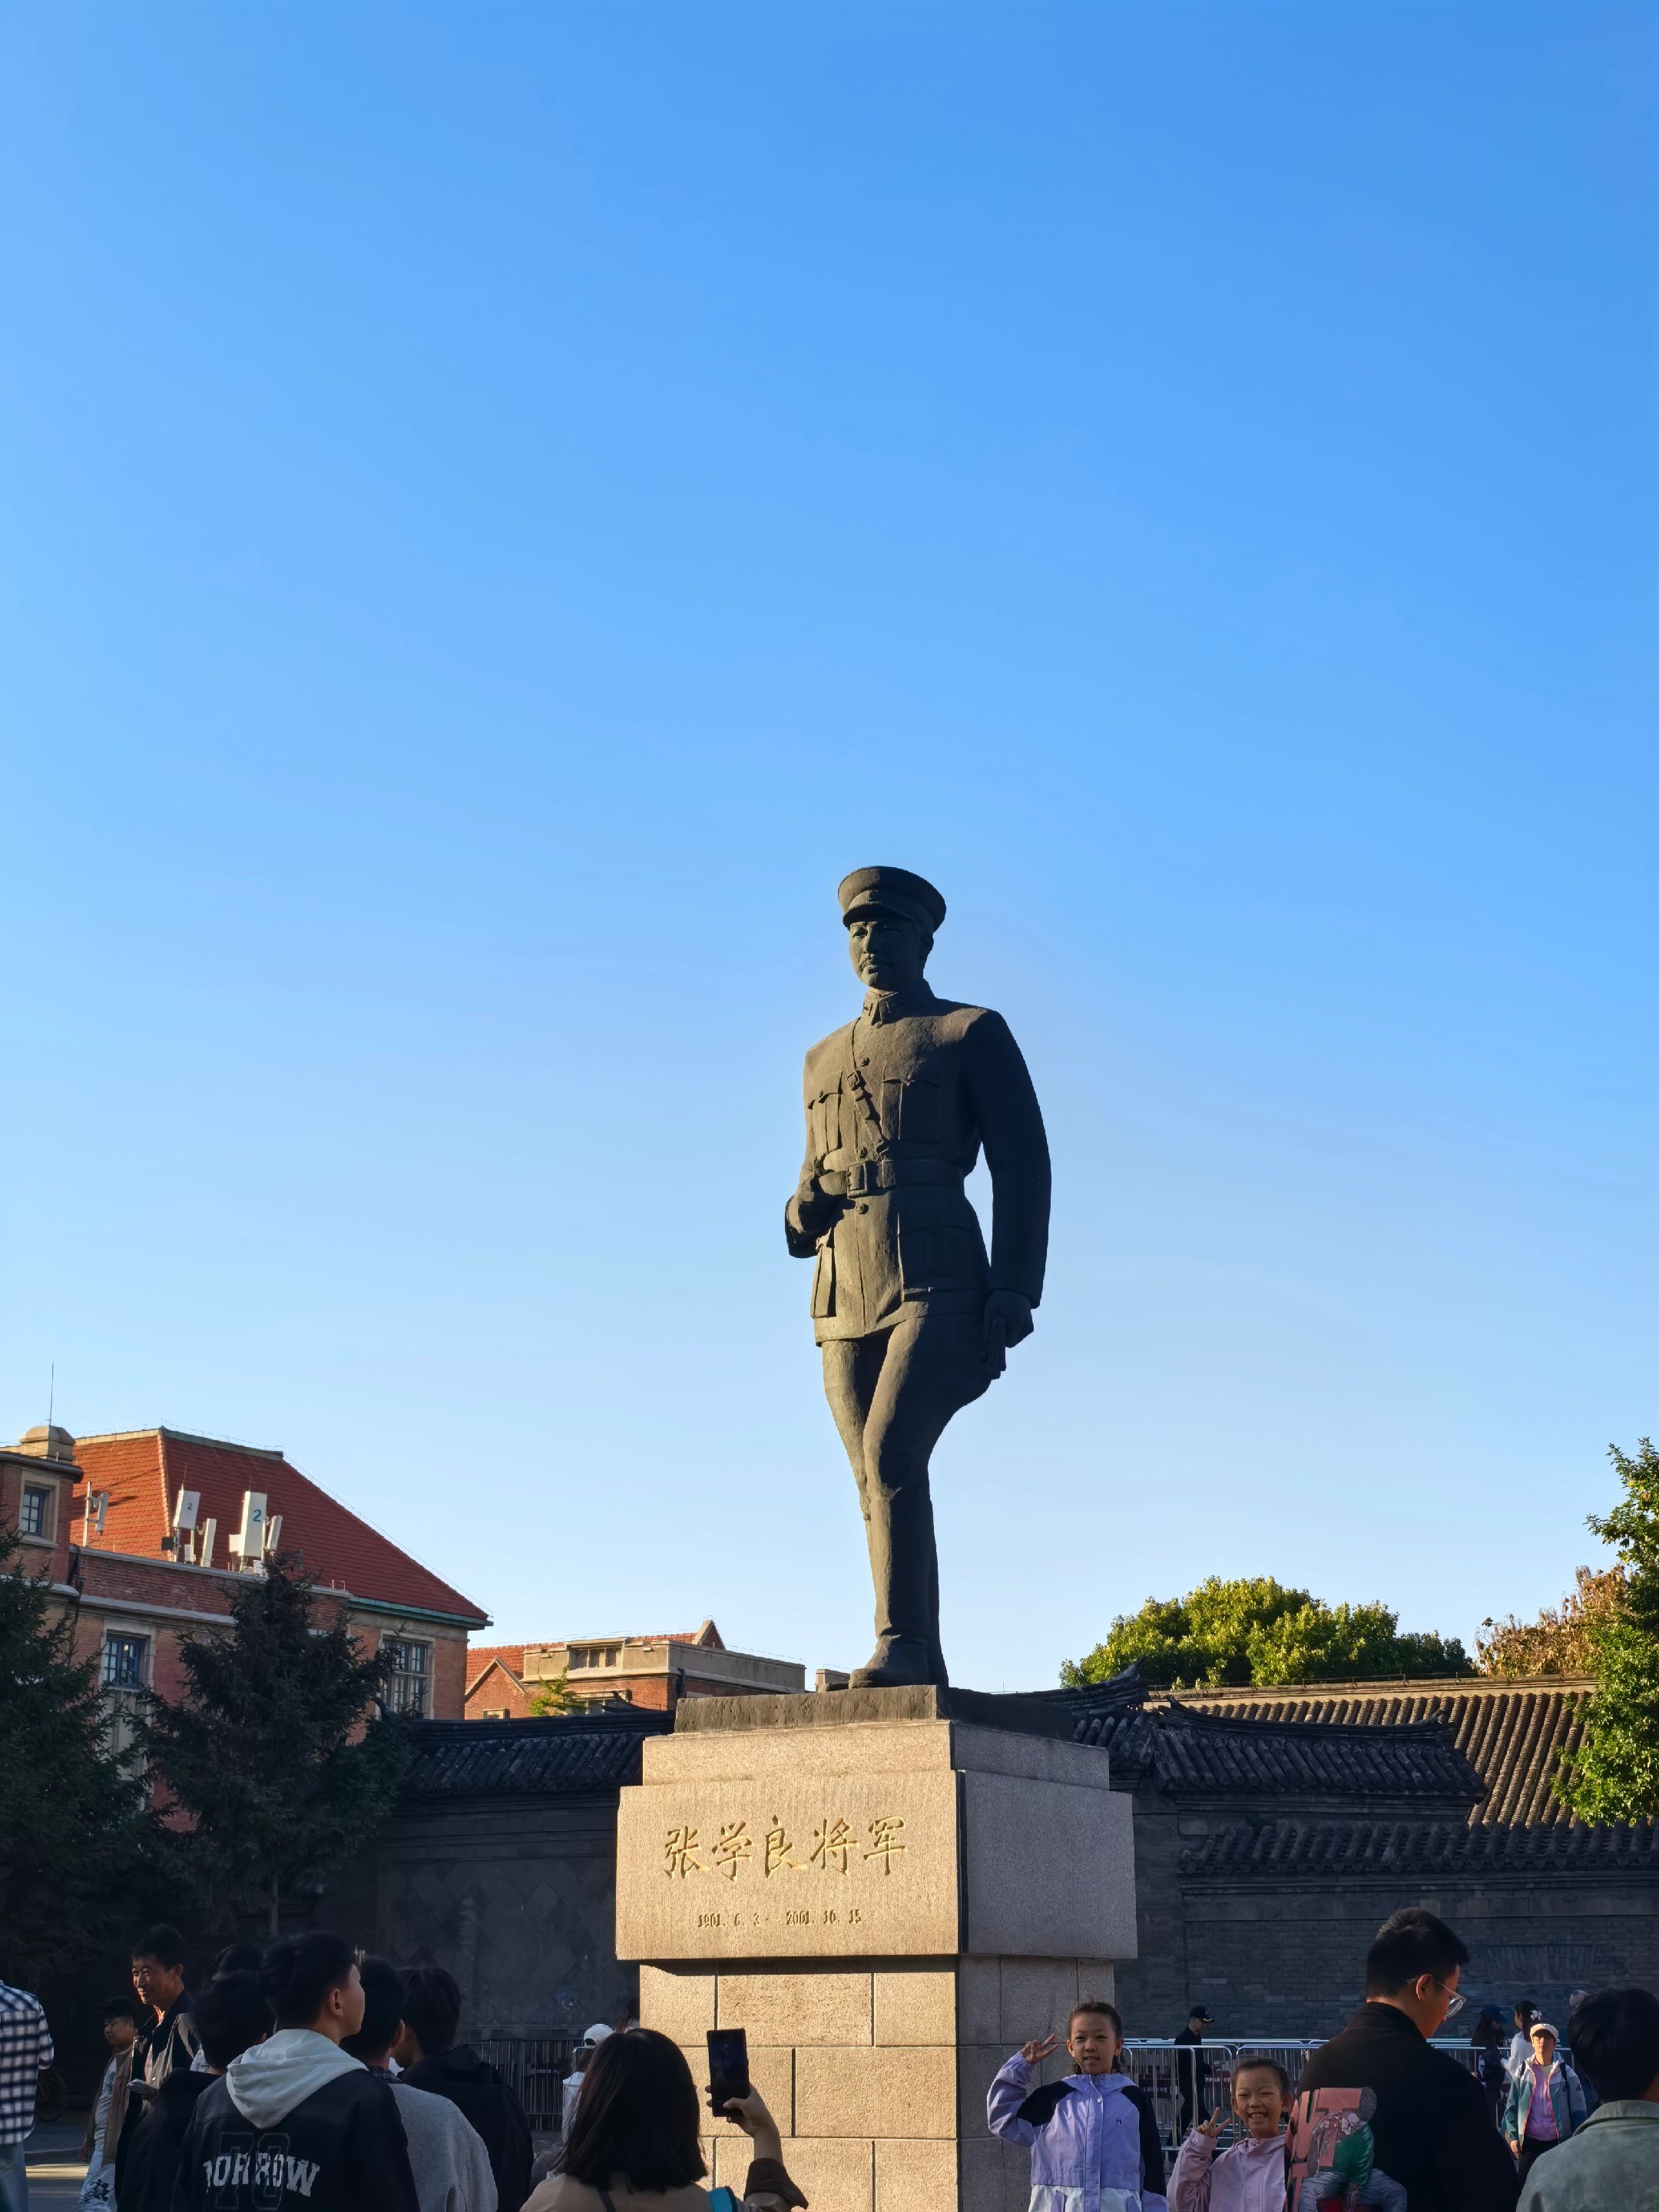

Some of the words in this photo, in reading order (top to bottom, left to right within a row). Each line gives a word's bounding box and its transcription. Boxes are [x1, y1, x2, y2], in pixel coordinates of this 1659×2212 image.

[187, 1502, 193, 1511] 2
[253, 1509, 262, 1522] 2
[664, 1815, 909, 1882] 张学良将军
[848, 1909, 863, 1925] 15
